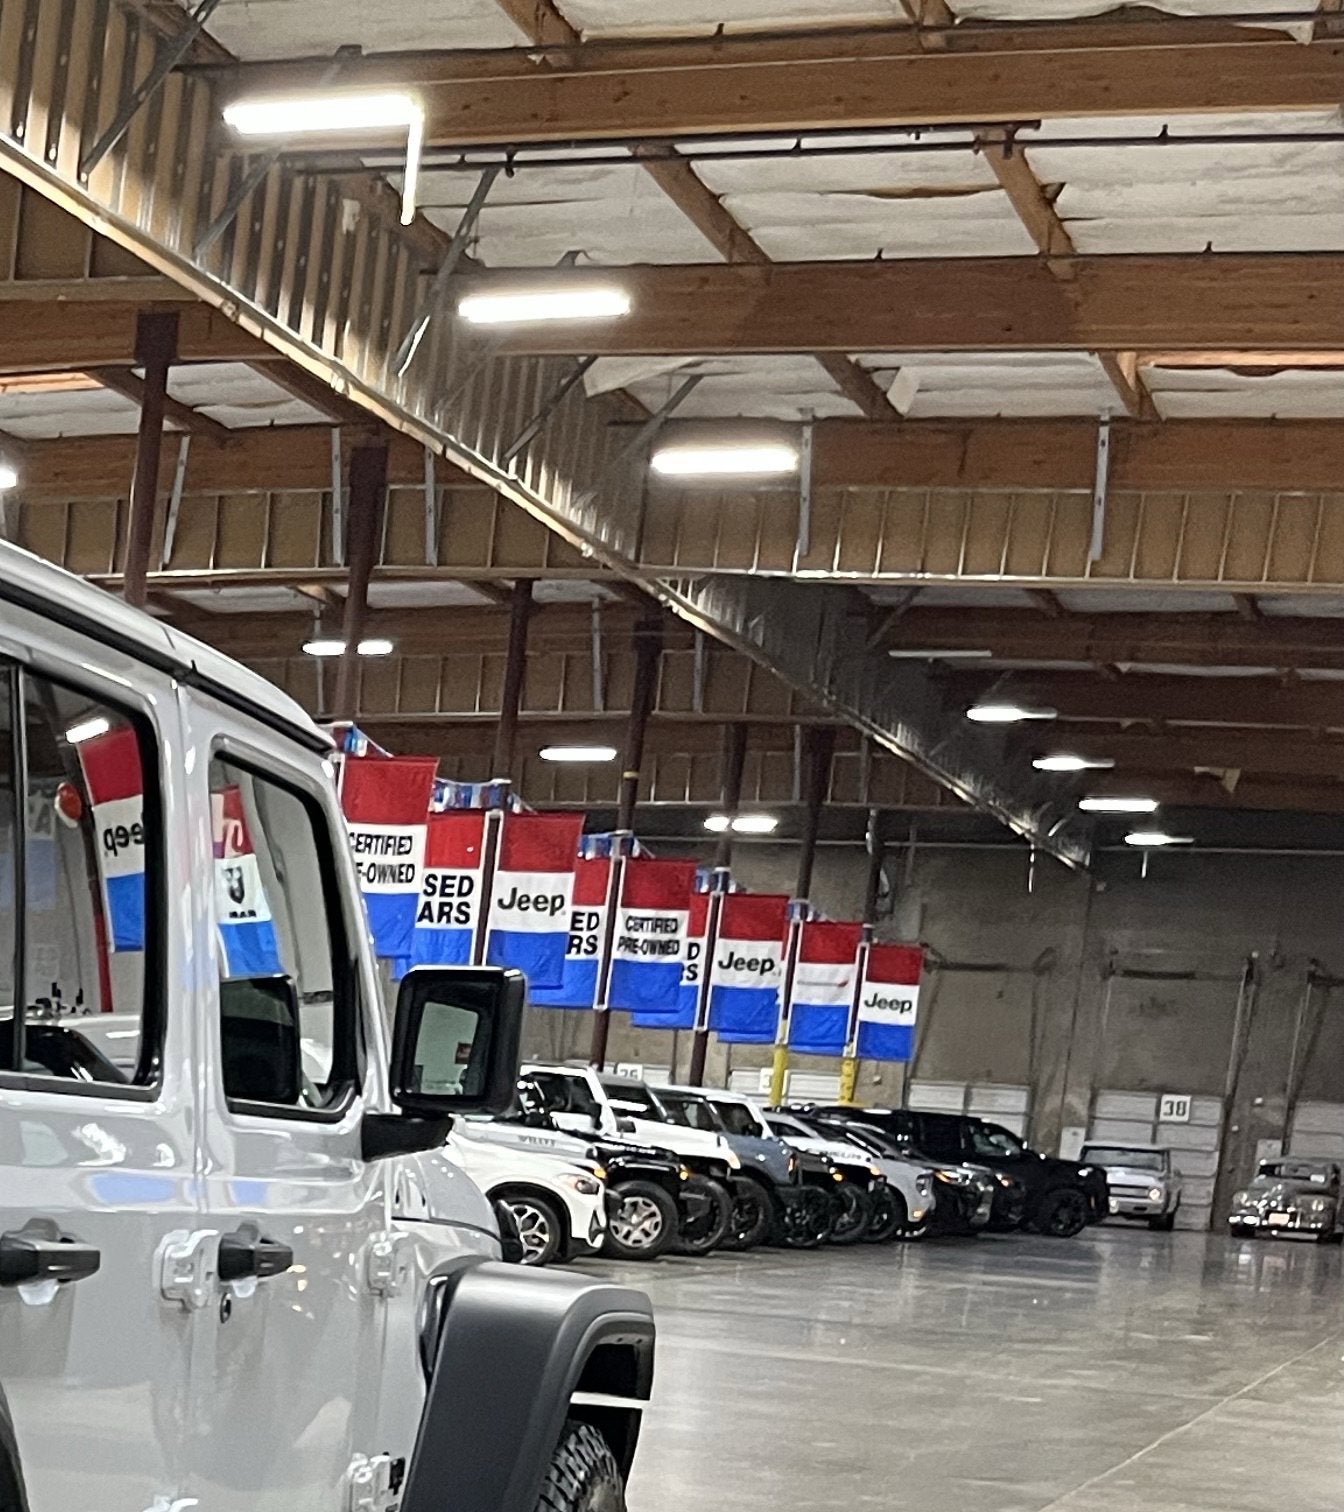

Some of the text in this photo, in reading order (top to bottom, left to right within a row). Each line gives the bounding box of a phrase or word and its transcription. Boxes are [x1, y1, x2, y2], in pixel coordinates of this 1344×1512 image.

[356, 862, 415, 884] E-OWNED
[423, 873, 474, 898] SED
[417, 901, 471, 924] ARS
[498, 887, 565, 916] Jeep
[618, 936, 680, 955] PRE-OWNED
[718, 952, 775, 976] Jeep
[864, 993, 912, 1014] Jeep
